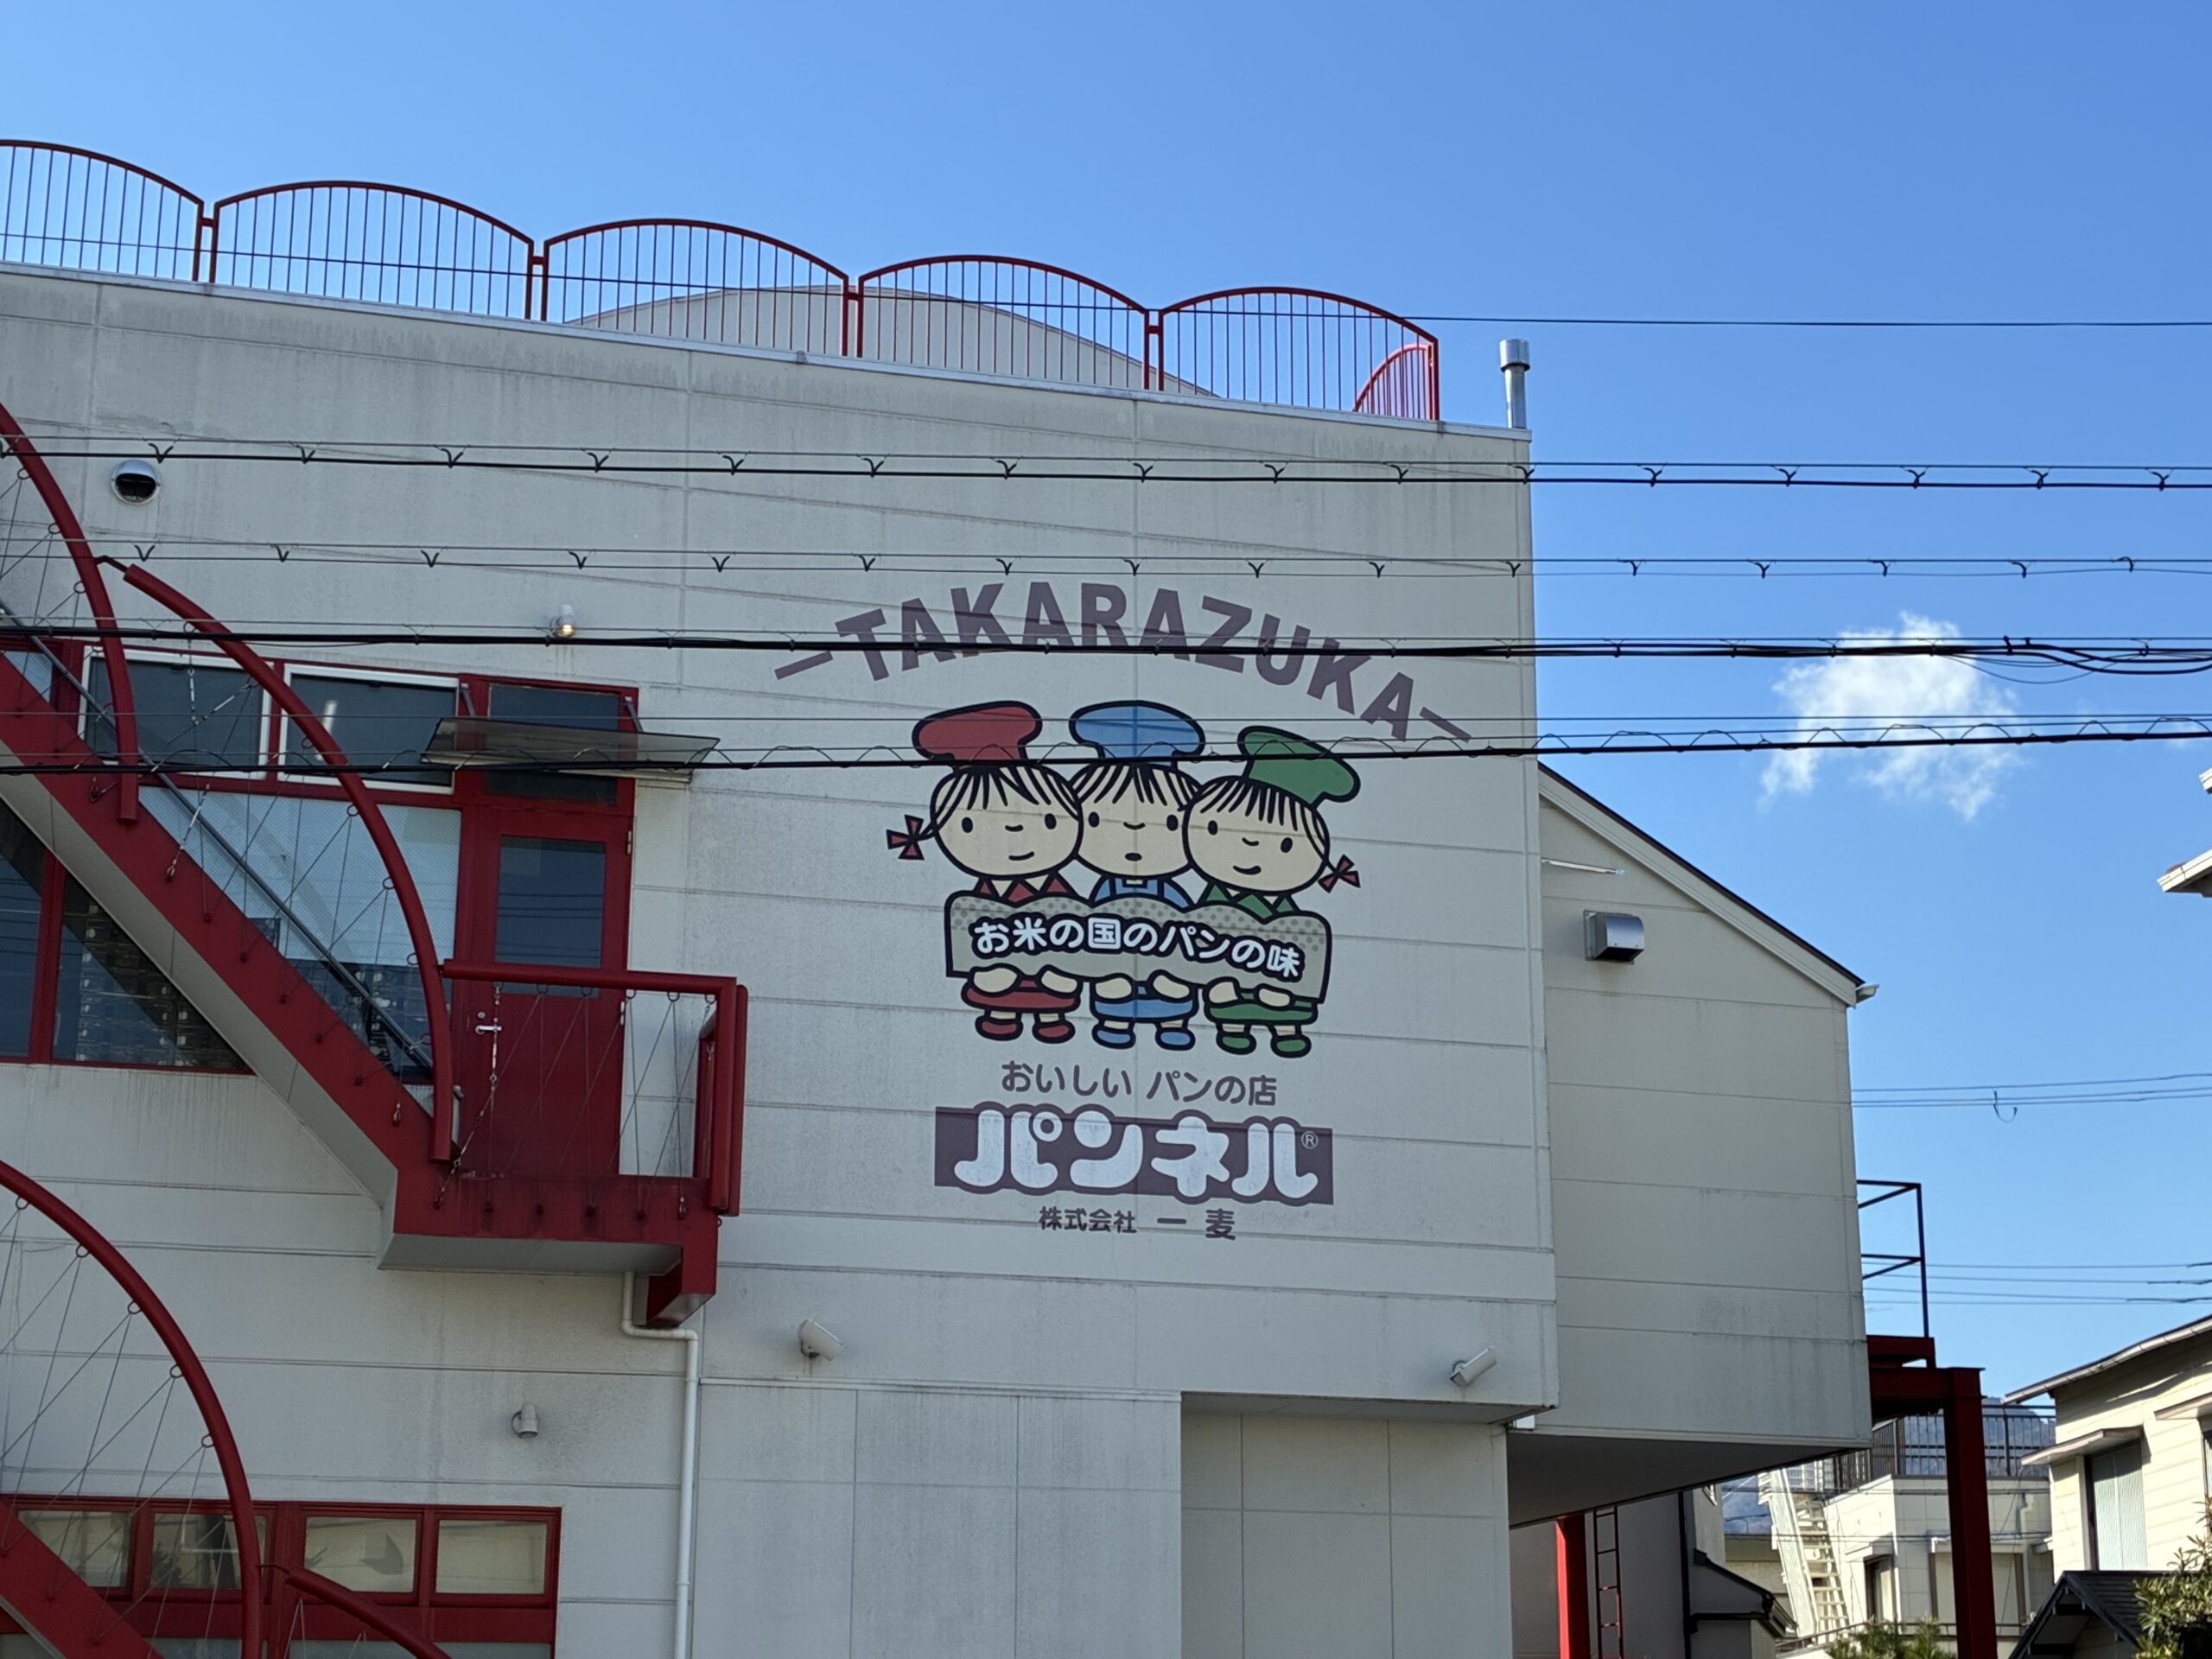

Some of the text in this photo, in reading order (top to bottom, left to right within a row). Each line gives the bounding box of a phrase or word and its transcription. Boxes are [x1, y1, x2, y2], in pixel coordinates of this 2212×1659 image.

[975, 918, 1301, 978] お米の国のパンの味
[1001, 1060, 1278, 1107] おいしい パンの店
[1039, 1206, 1138, 1234] 株式会社
